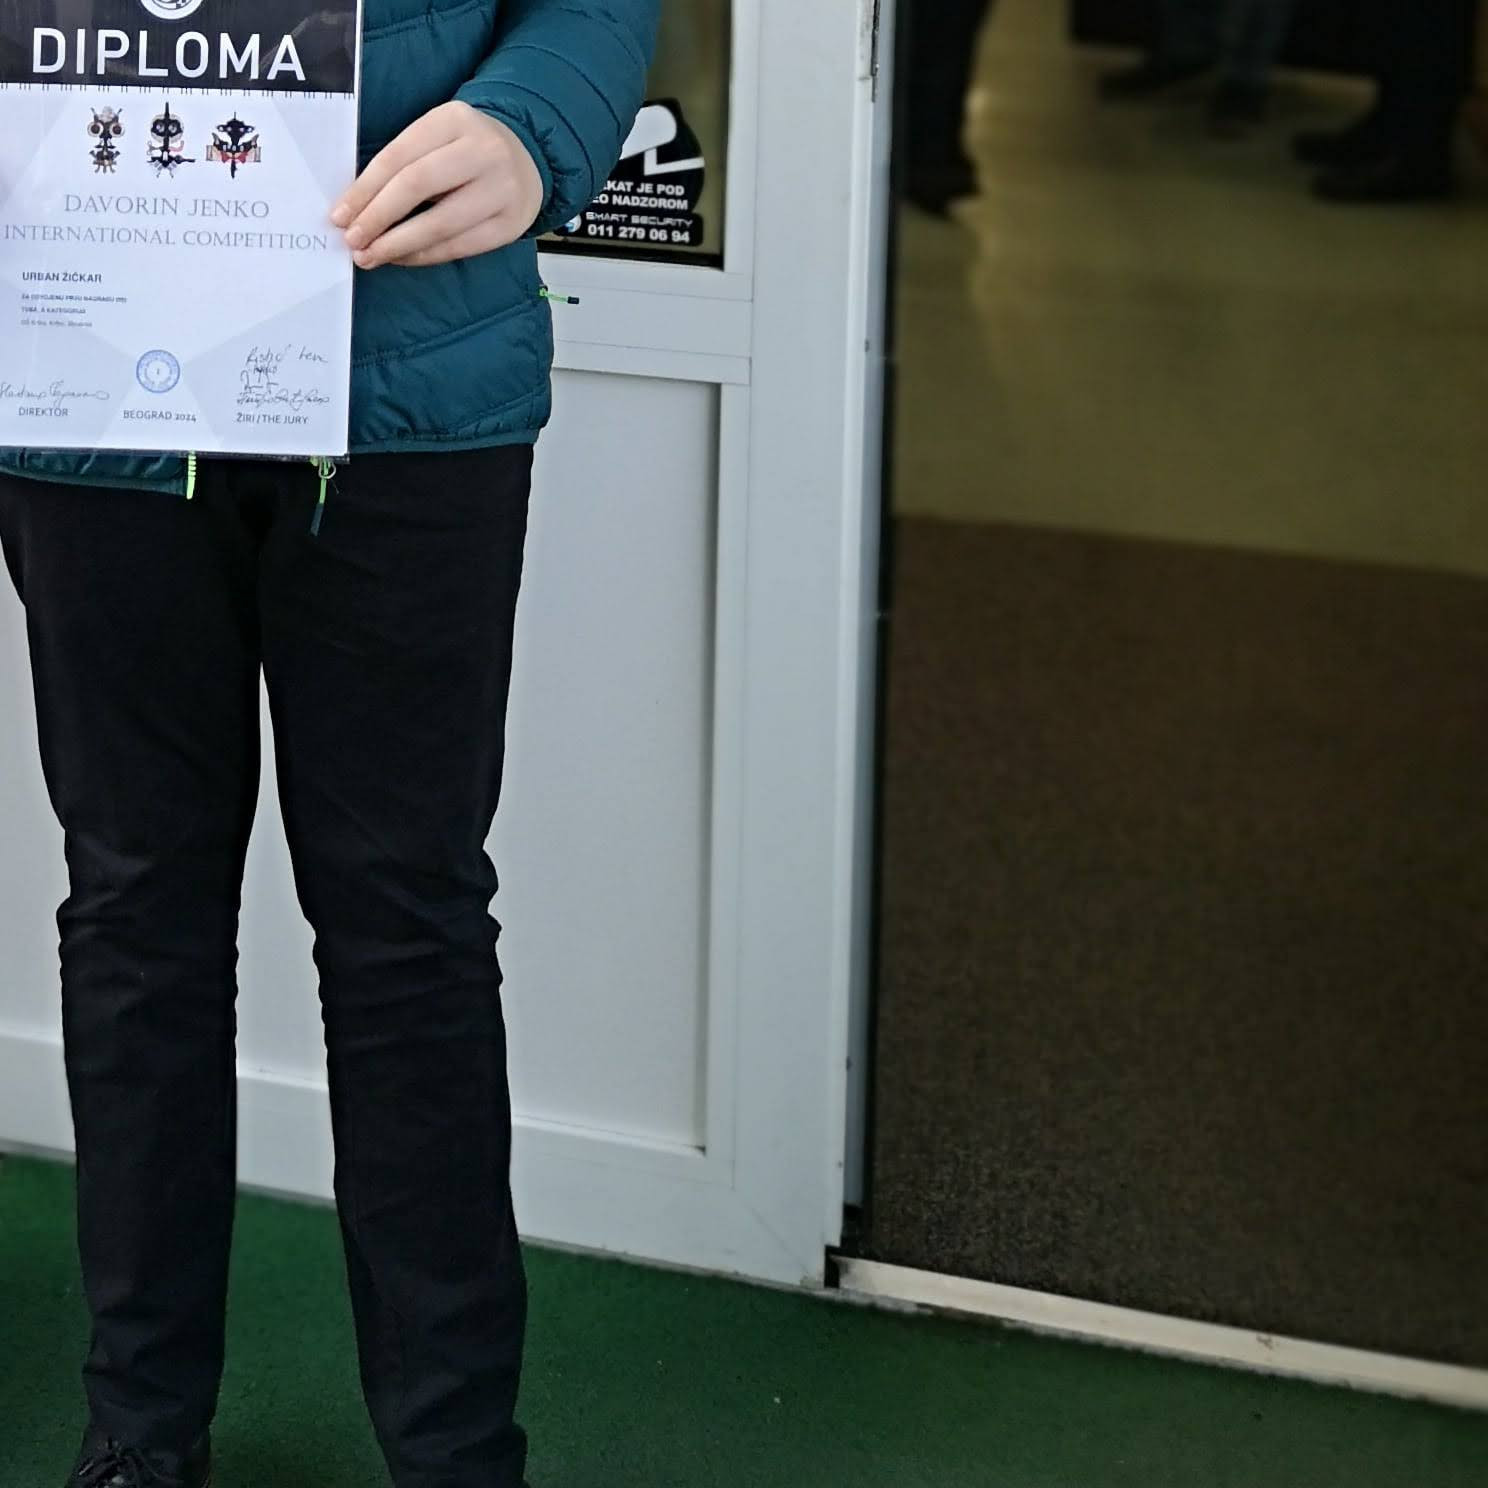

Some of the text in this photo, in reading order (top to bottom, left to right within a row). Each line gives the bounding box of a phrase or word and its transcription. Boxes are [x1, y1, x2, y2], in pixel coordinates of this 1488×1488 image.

[32, 27, 306, 81] DIPLOMA
[636, 182, 654, 194] JE
[657, 184, 685, 196] POD
[64, 194, 270, 219] DAVORIN JENKO
[612, 194, 689, 210] NADZOROM
[586, 211, 693, 227] SMART SECURITY
[4, 223, 328, 250] INTERNATIONAL COMPETITION
[587, 223, 690, 243] 011 279 06 94
[22, 271, 60, 282] URBAN
[18, 406, 69, 417] DIREKTOR
[123, 409, 197, 423] BEOGRAD 2024
[283, 414, 309, 425] JURY
